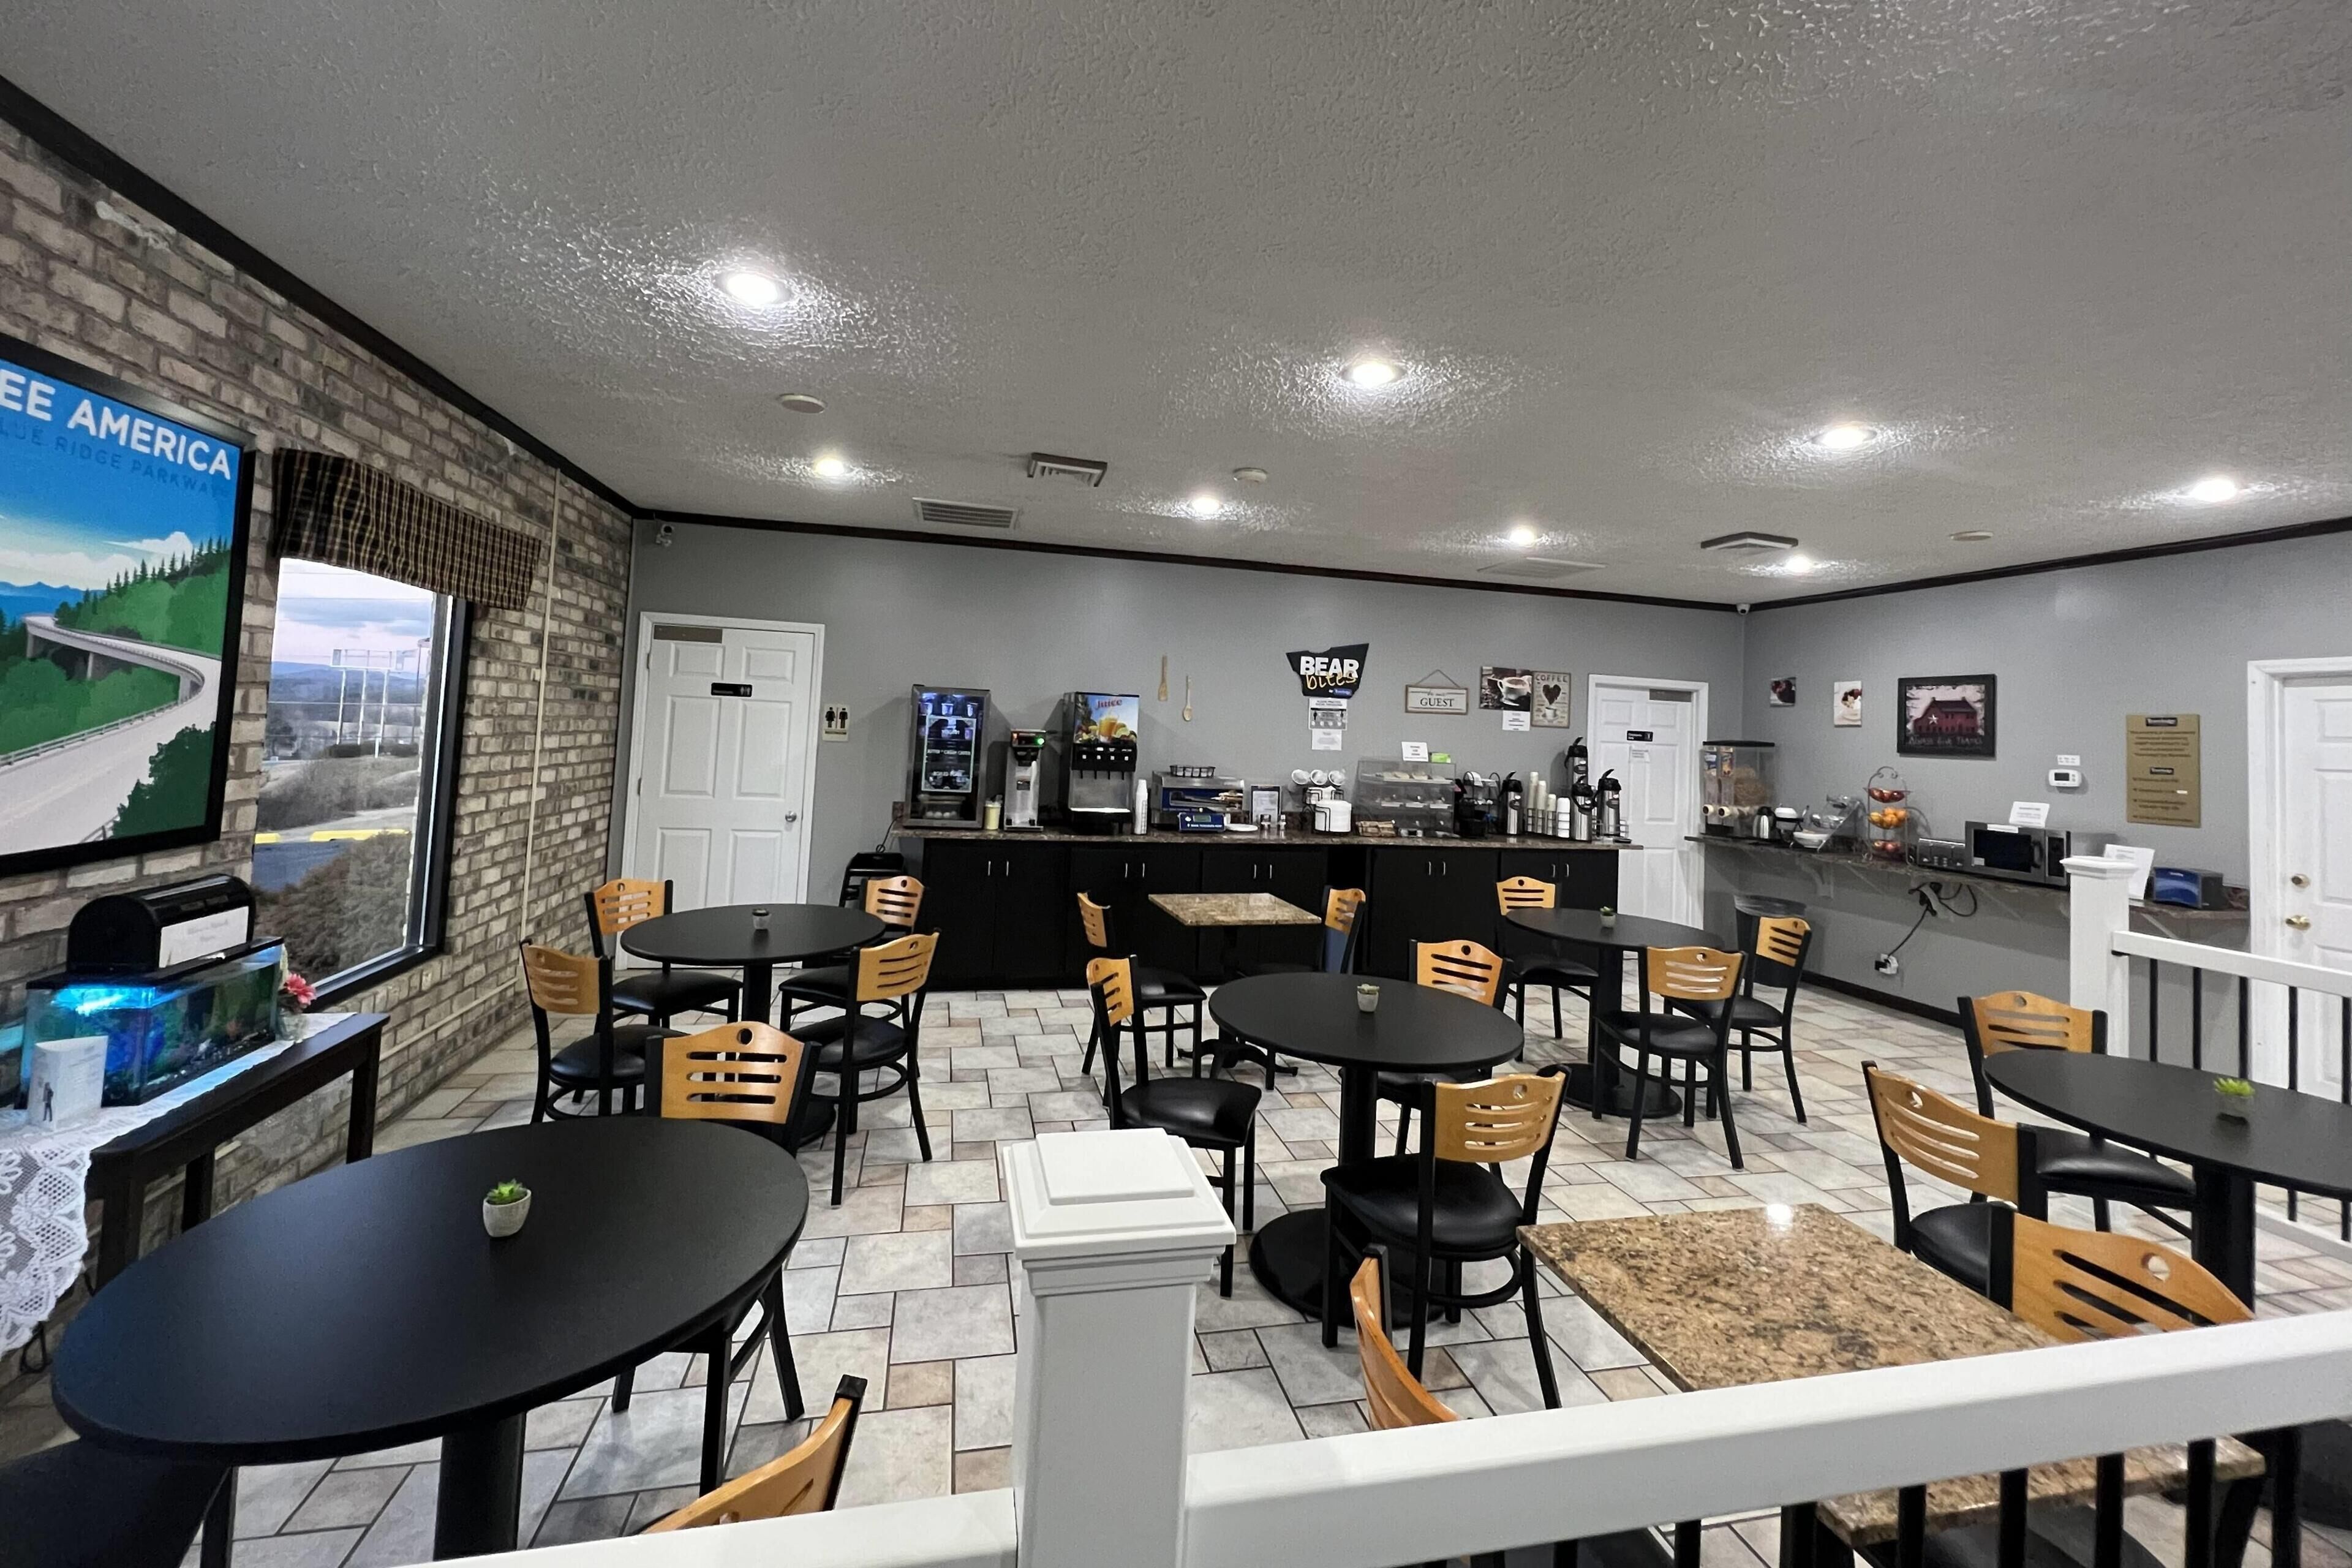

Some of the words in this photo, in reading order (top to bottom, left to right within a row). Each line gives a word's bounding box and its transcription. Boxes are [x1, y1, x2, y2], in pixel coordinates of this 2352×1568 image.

[67, 399, 231, 480] AMERICA
[55, 435, 122, 470] RIDGE
[1300, 656, 1359, 678] BEAR
[1305, 671, 1357, 690] bites
[1535, 674, 1568, 683] COFFEE
[1096, 698, 1123, 710] Juice
[1420, 698, 1455, 707] GUEST
